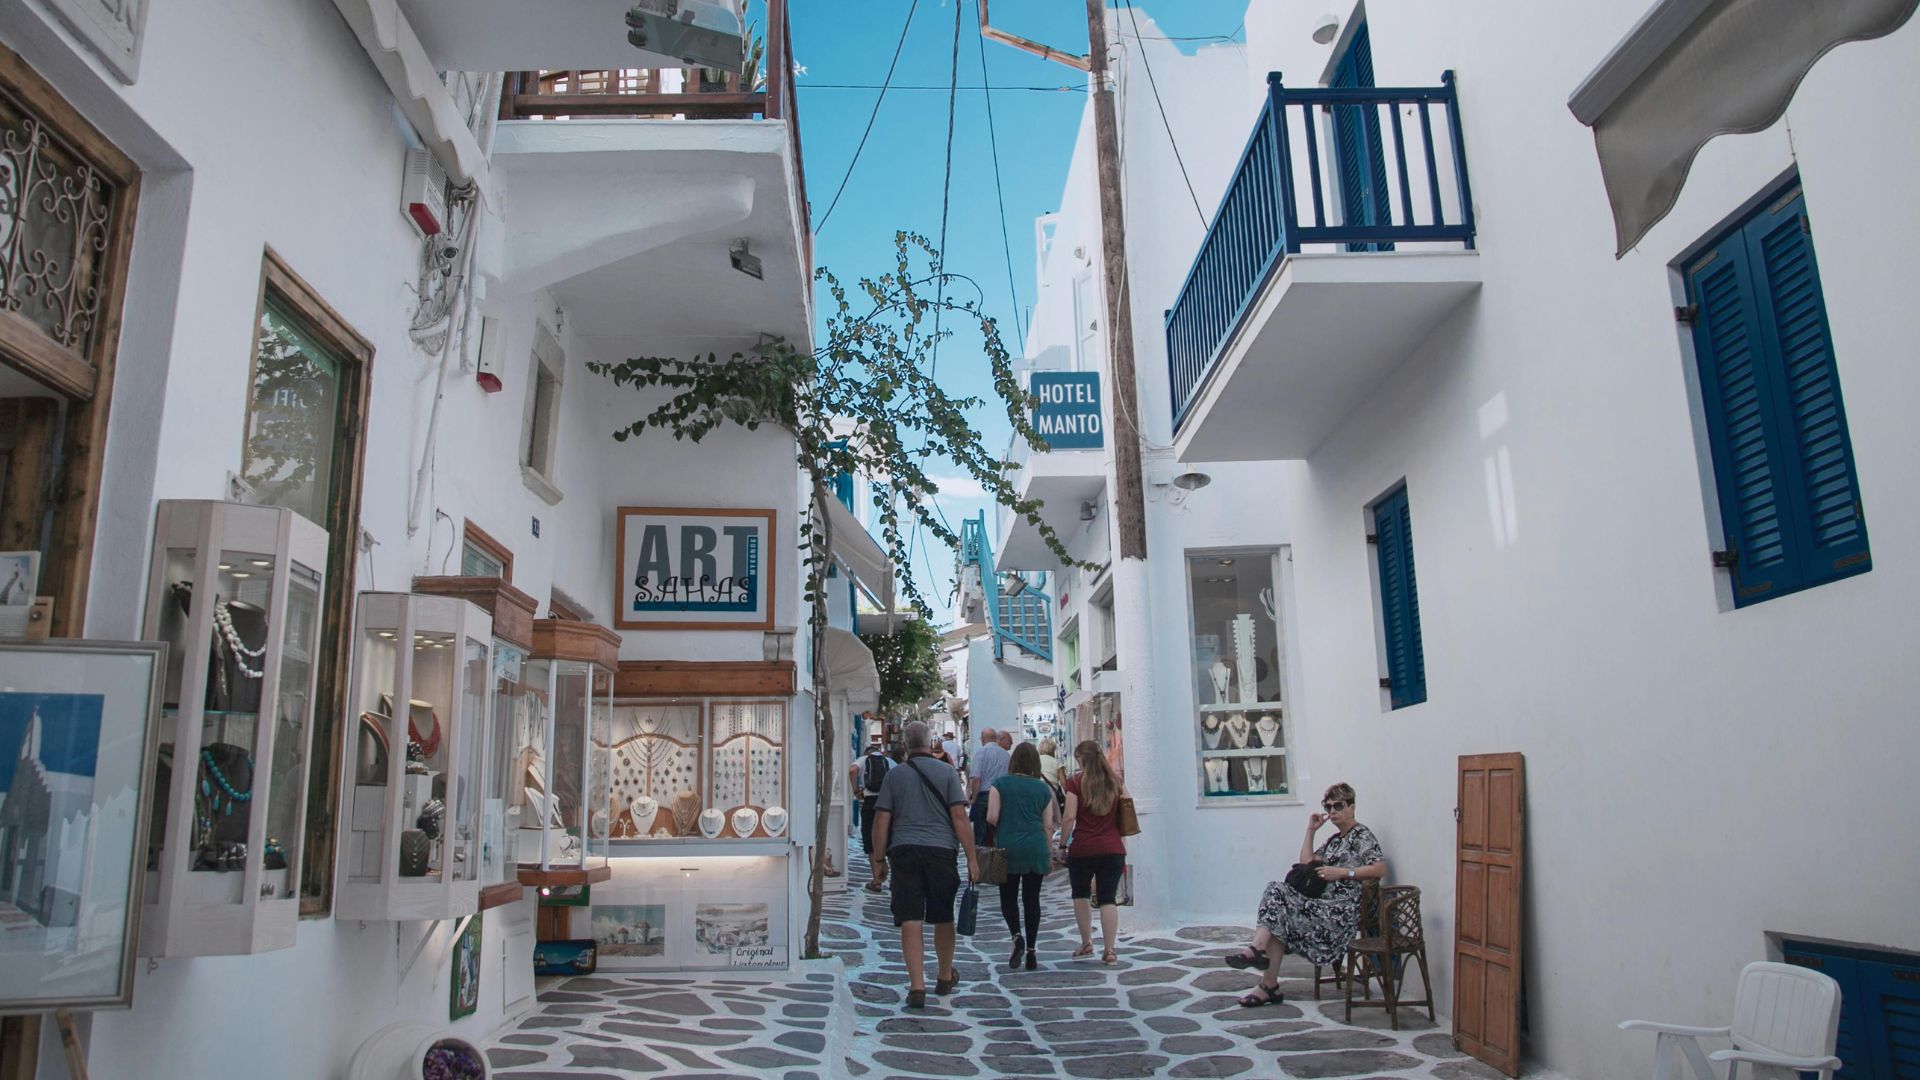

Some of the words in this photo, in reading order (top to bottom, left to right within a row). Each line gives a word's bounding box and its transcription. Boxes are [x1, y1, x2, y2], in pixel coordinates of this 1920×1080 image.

[1039, 384, 1096, 404] HOTEL
[1038, 414, 1100, 434] MANTO
[635, 525, 758, 587] ART
[634, 574, 755, 611] SAHAS
[736, 946, 774, 960] Original
